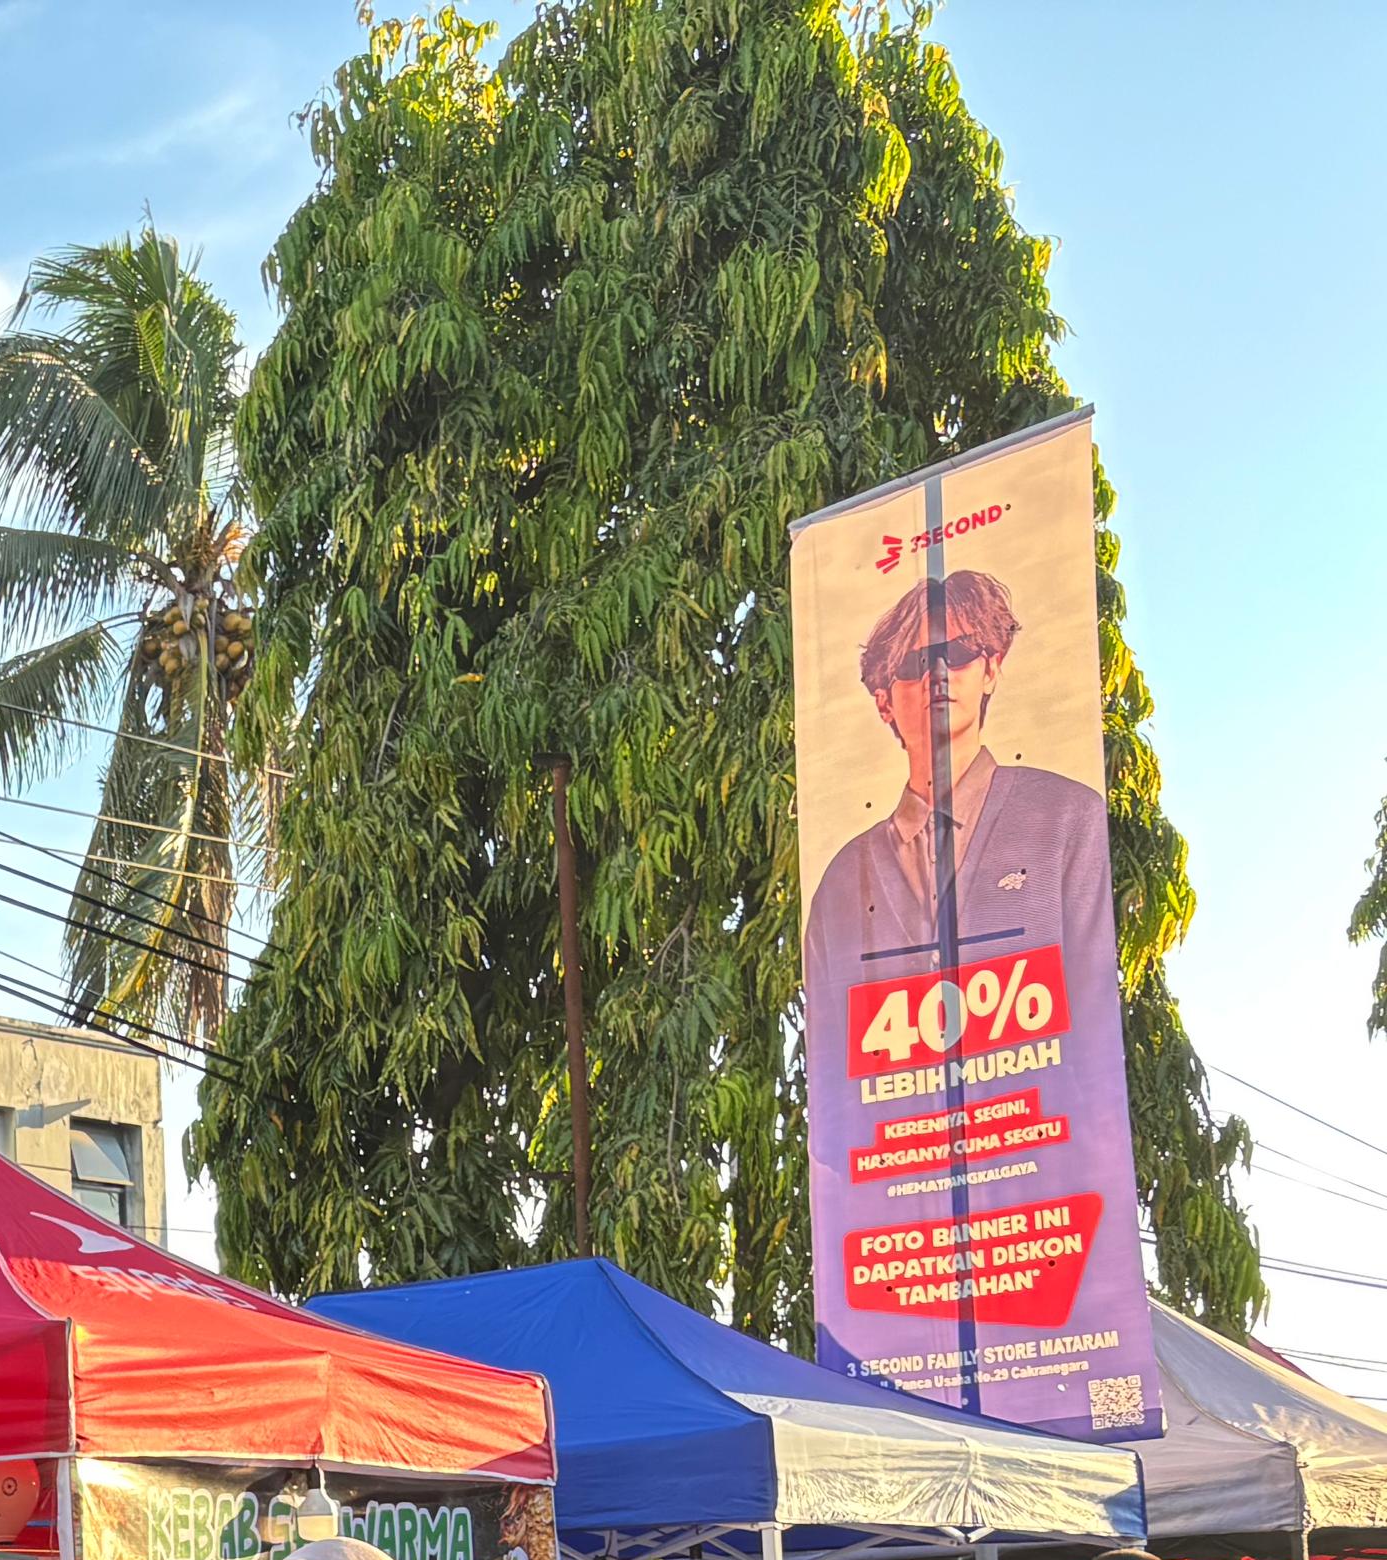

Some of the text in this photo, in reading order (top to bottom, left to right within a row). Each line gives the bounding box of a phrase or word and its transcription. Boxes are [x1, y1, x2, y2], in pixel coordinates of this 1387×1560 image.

[861, 959, 1053, 1062] 40%
[860, 1039, 1062, 1105] LEBIH MURAH
[884, 1099, 1031, 1140] KERENNYA SEGINI,
[953, 1133, 1001, 1155] CUMA
[1003, 1121, 1062, 1147] SEGITU
[860, 1206, 1071, 1257] FOTO BANNER INI
[853, 1233, 1083, 1285] DAPATKAN DISKON
[846, 1330, 1119, 1378] 3 SECOND FAMILY STORE MATARAM
[894, 1377, 931, 1391] Panca
